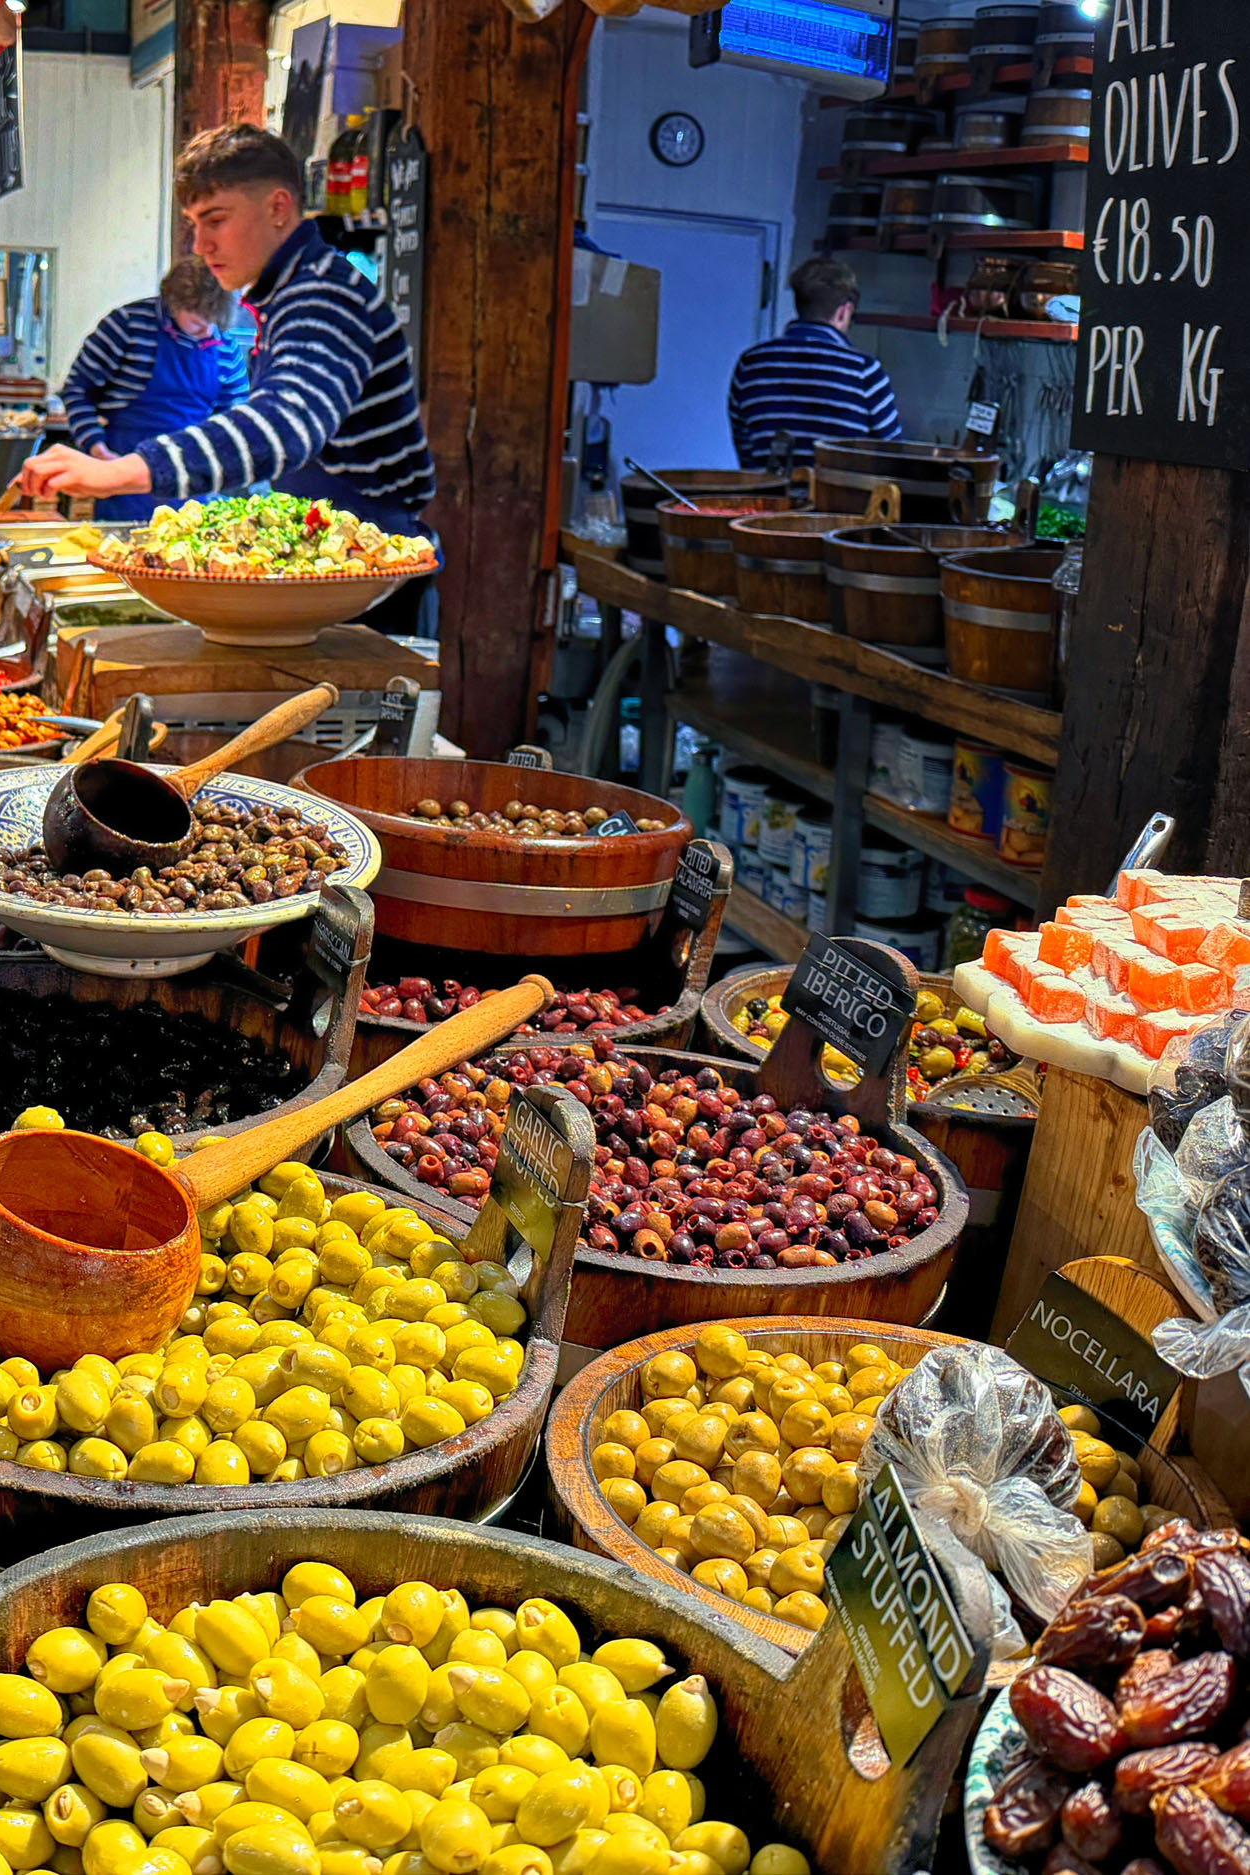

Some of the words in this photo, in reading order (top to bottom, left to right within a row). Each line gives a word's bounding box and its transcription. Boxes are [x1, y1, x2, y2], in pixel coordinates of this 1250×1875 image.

[1108, 0, 1175, 63] ALL
[1104, 59, 1240, 175] OLIVES
[1092, 197, 1214, 288] €18.50
[1085, 325, 1144, 416] PER
[1177, 322, 1225, 427] KG
[685, 846, 712, 874] PITTED
[802, 966, 887, 1038] IBERICO
[822, 947, 893, 1010] PITTED
[794, 1006, 807, 1018] MAY
[806, 1014, 830, 1036] CONTAIN
[817, 1010, 851, 1039] PORTUGAL
[515, 1101, 564, 1173] GARLIC
[1030, 1300, 1161, 1423] NOCELLARA
[851, 1520, 934, 1708] STUFFED
[873, 1486, 960, 1682] ALMOND
[839, 1606, 854, 1638] NUTS
[856, 1624, 882, 1680] GREECE
